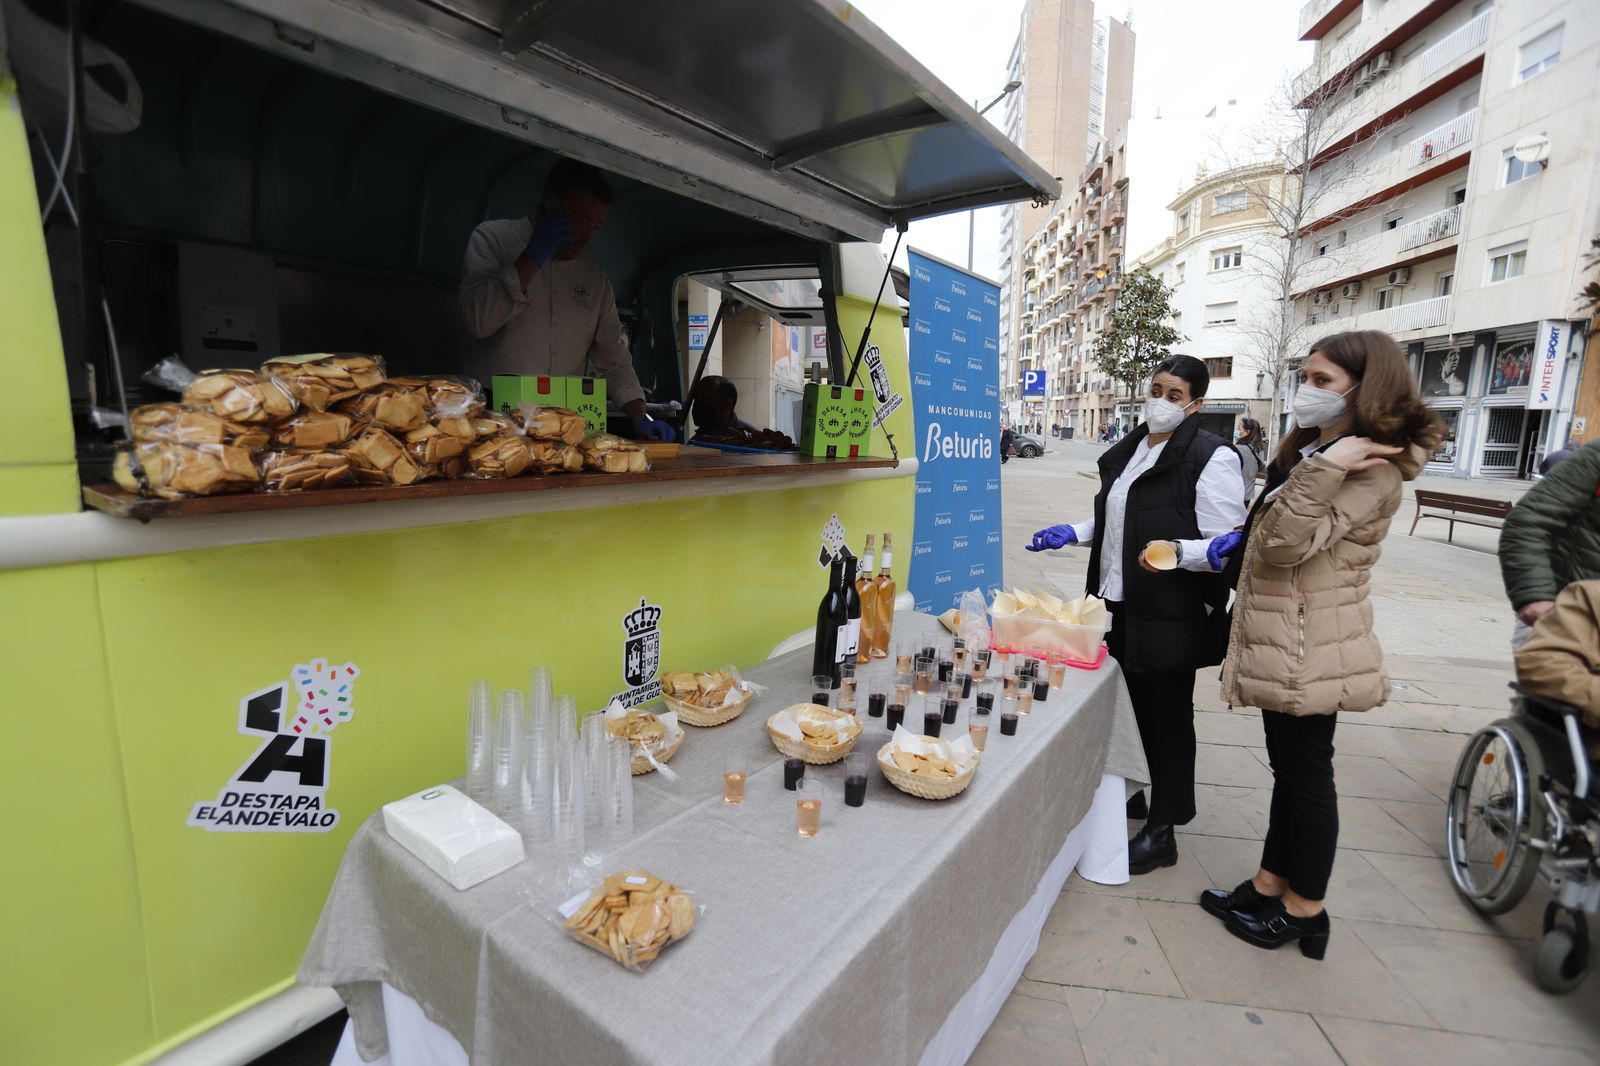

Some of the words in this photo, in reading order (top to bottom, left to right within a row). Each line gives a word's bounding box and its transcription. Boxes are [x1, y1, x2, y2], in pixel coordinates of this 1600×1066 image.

[1541, 326, 1560, 391] INTERSPORT
[1025, 371, 1037, 390] P
[822, 405, 847, 417] DEHESA
[929, 405, 992, 419] MANCOMUNIDAD
[824, 421, 848, 438] HERMANAS
[924, 423, 992, 462] Beturia
[633, 694, 644, 705] DE
[221, 792, 320, 810] DESTAPA
[196, 806, 218, 820] EL
[215, 807, 335, 827] ANDÉVALO
